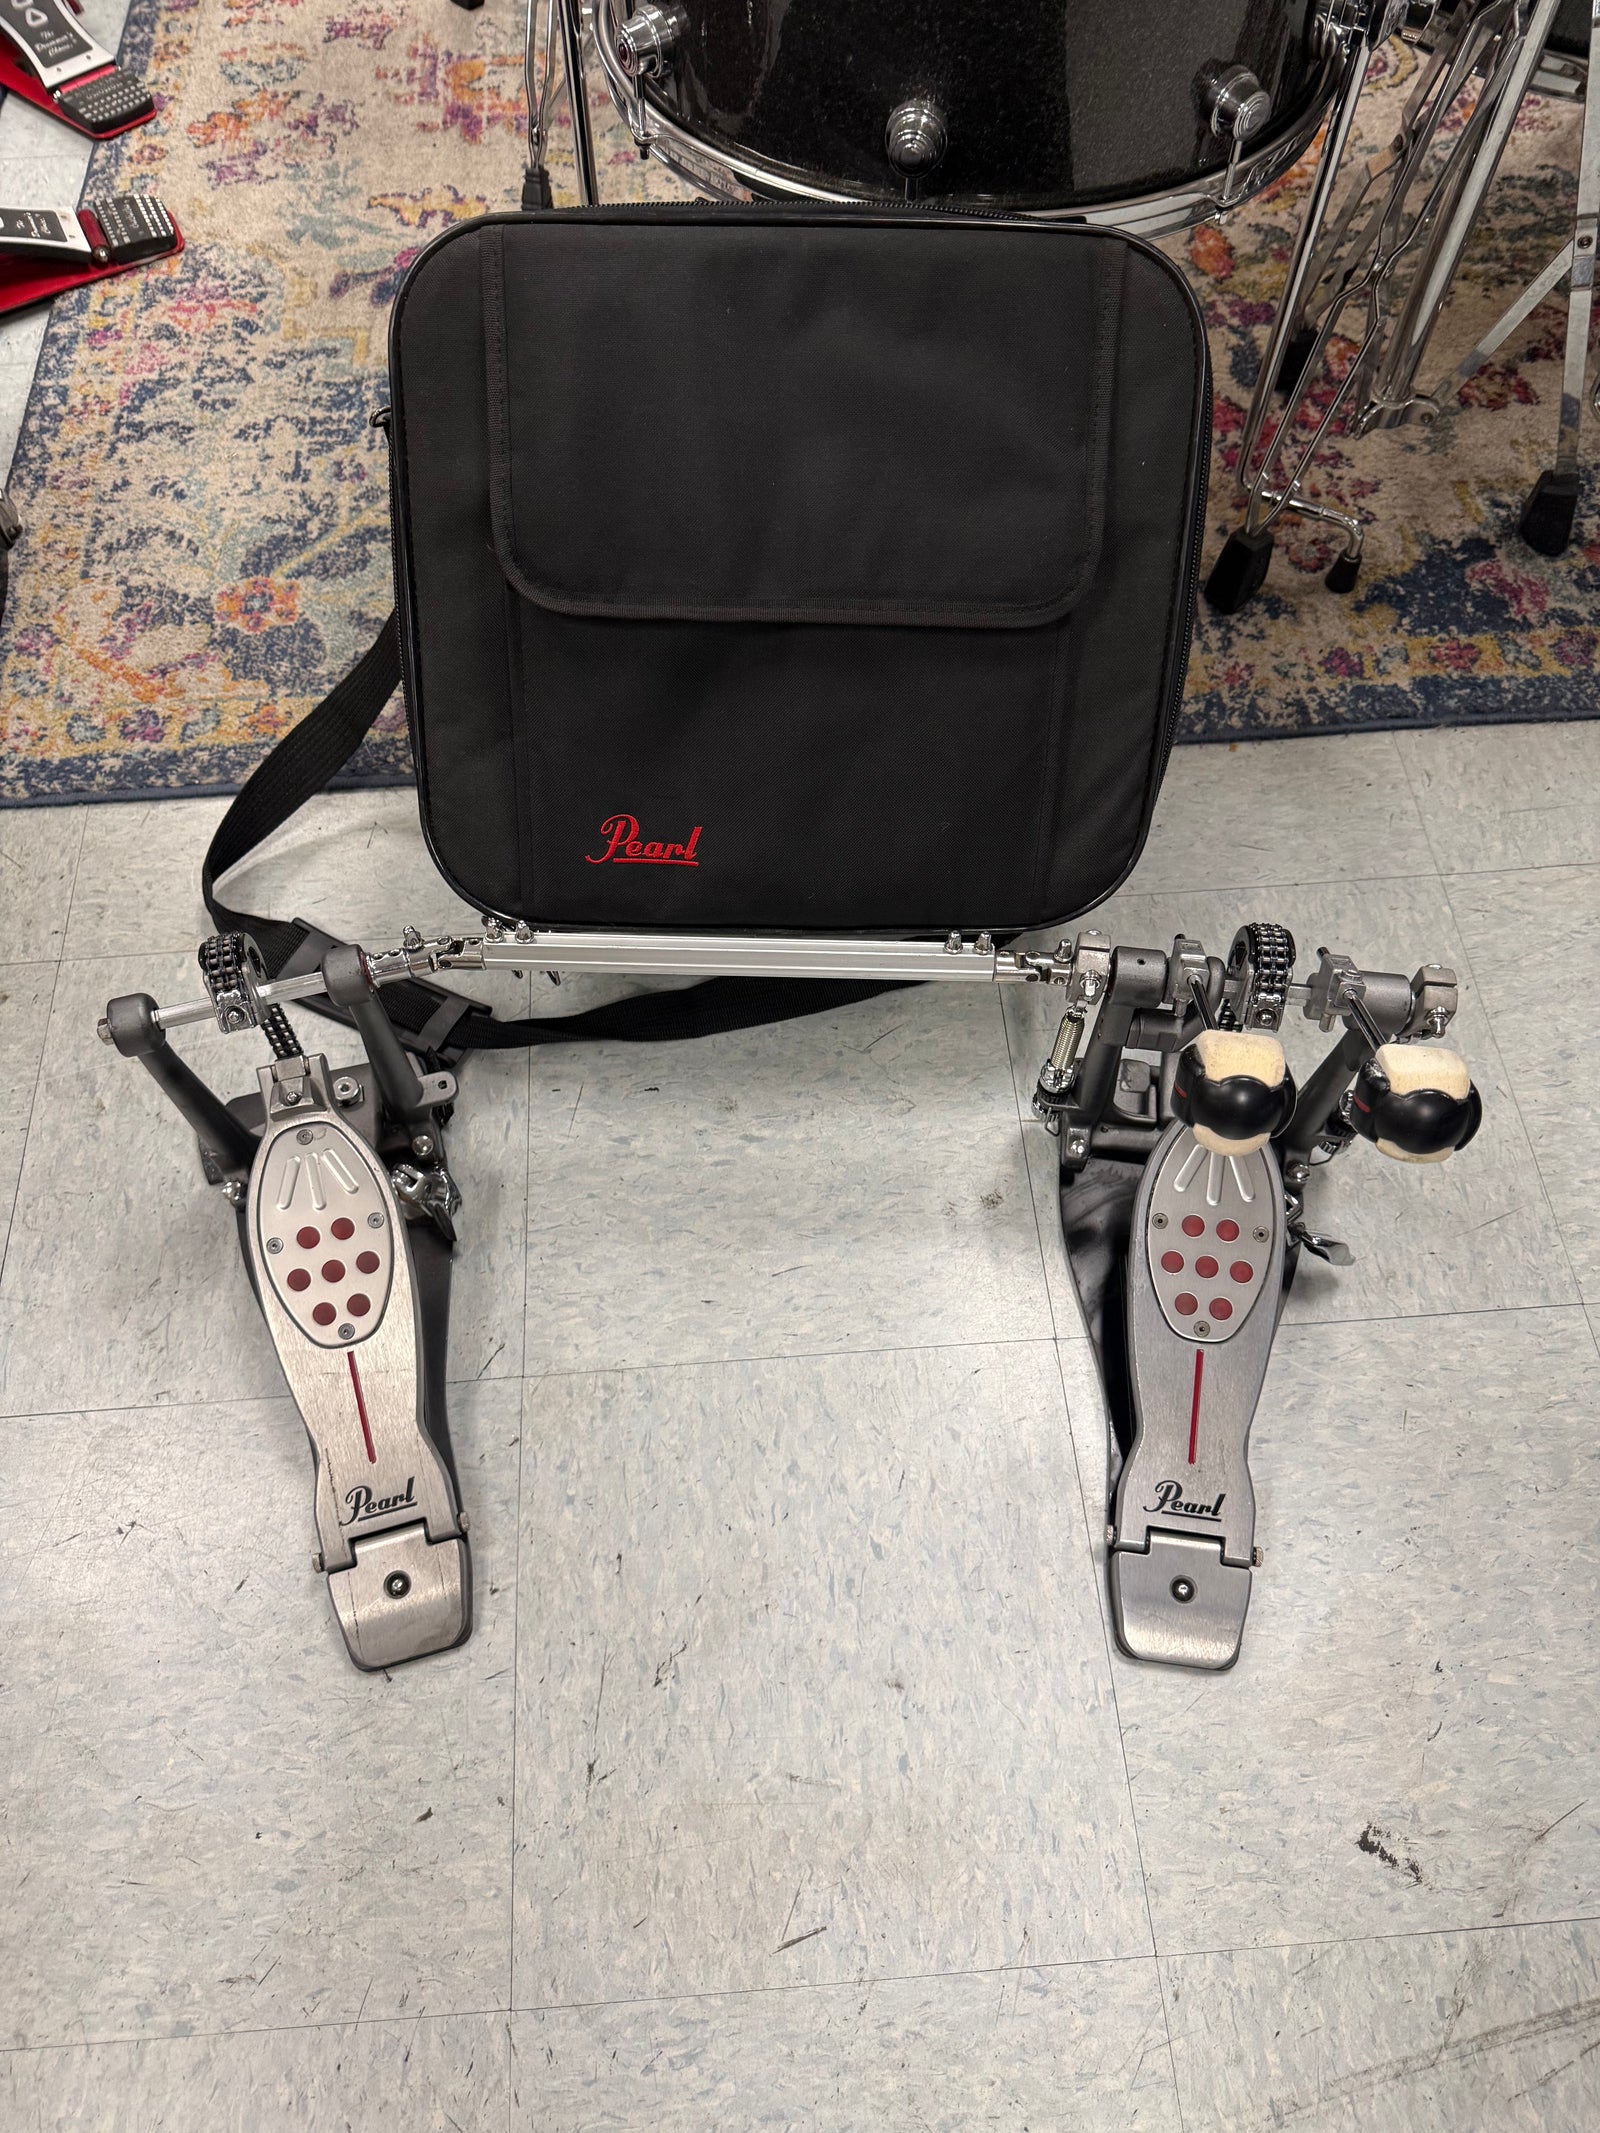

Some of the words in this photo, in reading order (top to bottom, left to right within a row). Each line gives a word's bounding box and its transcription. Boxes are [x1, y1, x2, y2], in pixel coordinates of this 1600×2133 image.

[585, 813, 703, 867] Pearl
[339, 1476, 418, 1527] Pearl
[1143, 1480, 1227, 1523] Pearl
